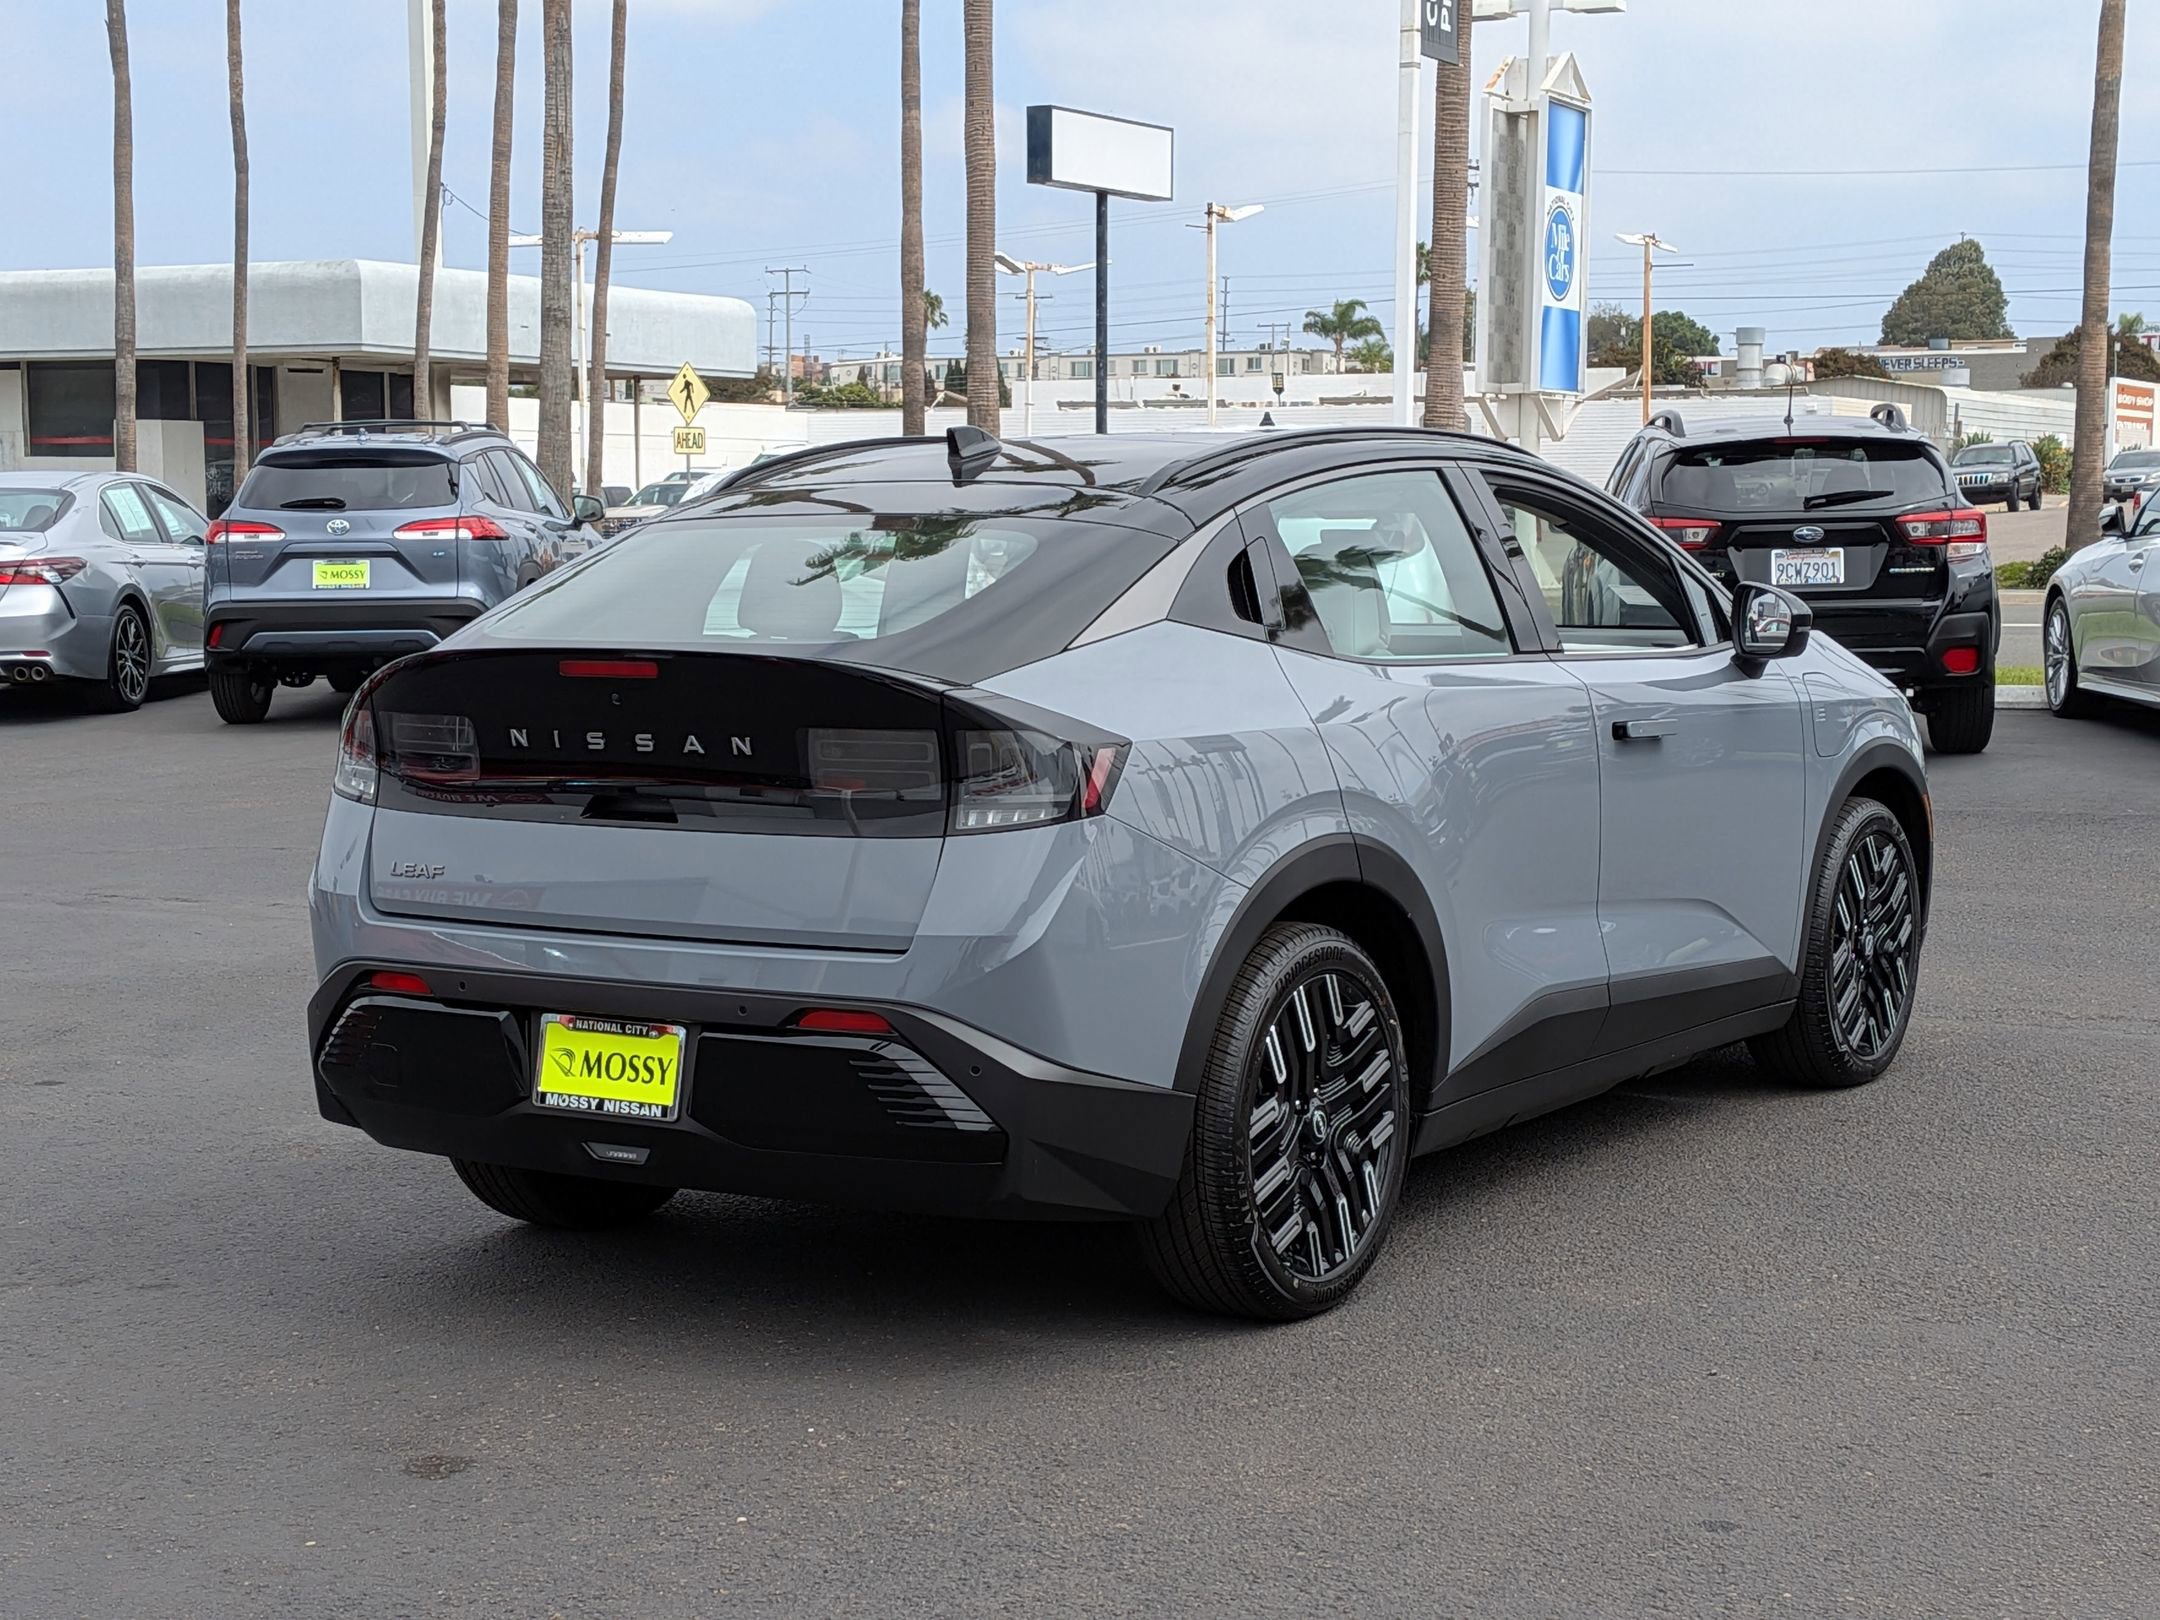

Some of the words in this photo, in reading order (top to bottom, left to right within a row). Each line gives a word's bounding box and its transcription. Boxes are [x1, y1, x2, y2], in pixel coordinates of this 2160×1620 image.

[1548, 253, 1570, 283] Cars
[676, 432, 703, 449] AHEAD
[330, 569, 366, 580] MOSSY
[1776, 562, 1837, 579] 9CWZ901
[509, 728, 752, 756] NISSAN
[390, 861, 445, 880] LEAF
[1274, 946, 1346, 995] BRIDGESTONE
[576, 1019, 623, 1034] NATIONAL
[625, 1024, 649, 1036] CITY
[579, 1050, 673, 1086] MOSSY
[545, 1093, 600, 1110] MOSSY
[603, 1099, 662, 1118] NISSAN
